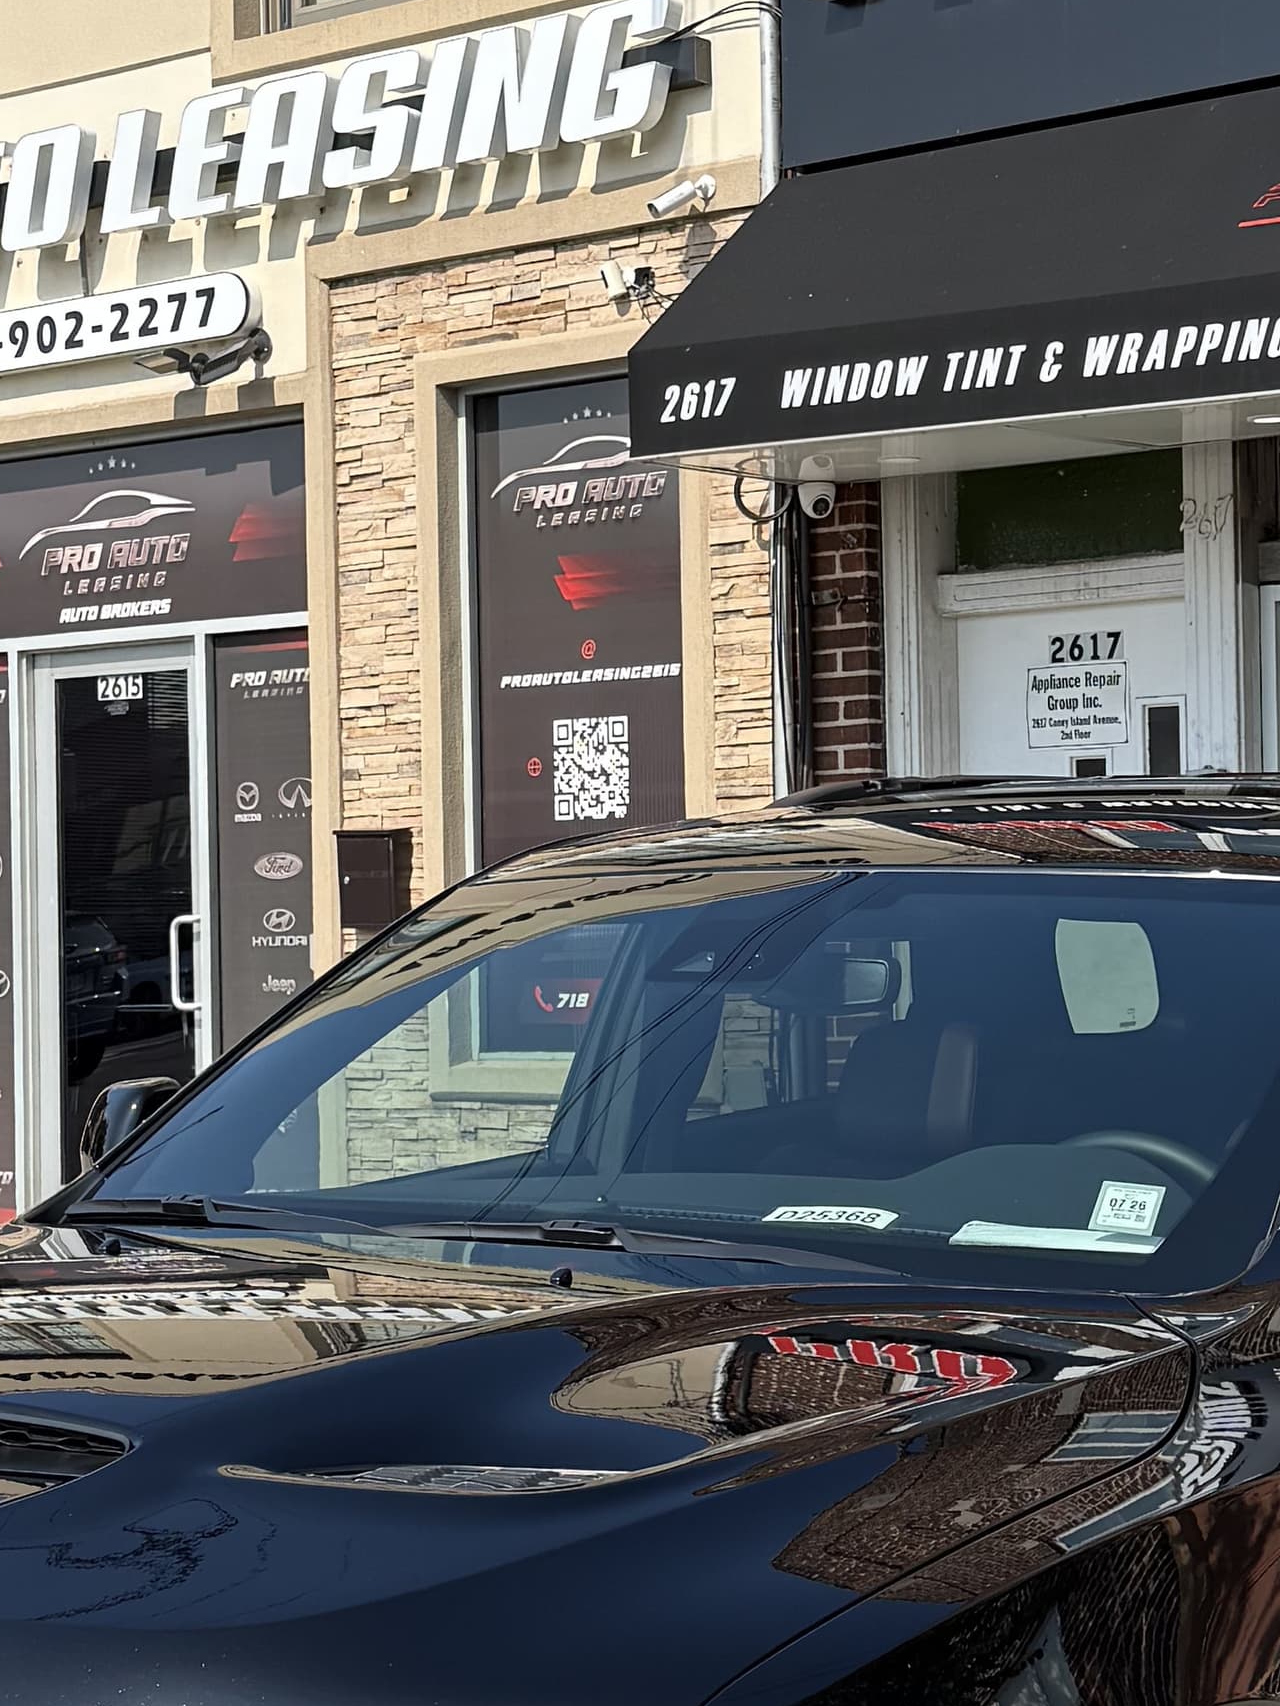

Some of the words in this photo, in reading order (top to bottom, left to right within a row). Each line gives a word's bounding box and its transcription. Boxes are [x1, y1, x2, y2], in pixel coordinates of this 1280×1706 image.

[779, 355, 928, 410] WINDOW
[942, 344, 1028, 392] TINT
[1038, 341, 1064, 383] &
[660, 377, 737, 424] 2617
[513, 481, 577, 512] PRO
[582, 470, 667, 505] AUTO
[536, 503, 643, 528] LEASING
[41, 542, 103, 576] PRO
[108, 533, 191, 568] AUTO
[63, 571, 167, 596] LEASING
[60, 605, 100, 624] AUTO
[101, 599, 172, 620] BROKERS
[1051, 631, 1121, 663] 2617
[100, 677, 141, 699] 2615
[230, 670, 267, 688] PRO
[1031, 674, 1081, 693] Appliance
[1085, 670, 1122, 689] Repair
[1047, 695, 1079, 712] Group
[1082, 693, 1102, 708] Inc.
[264, 856, 294, 874] Ford
[252, 935, 307, 948] HYUNDAI
[262, 975, 297, 996] Jeep
[556, 993, 589, 1009] 718
[1110, 1198, 1126, 1208] 07
